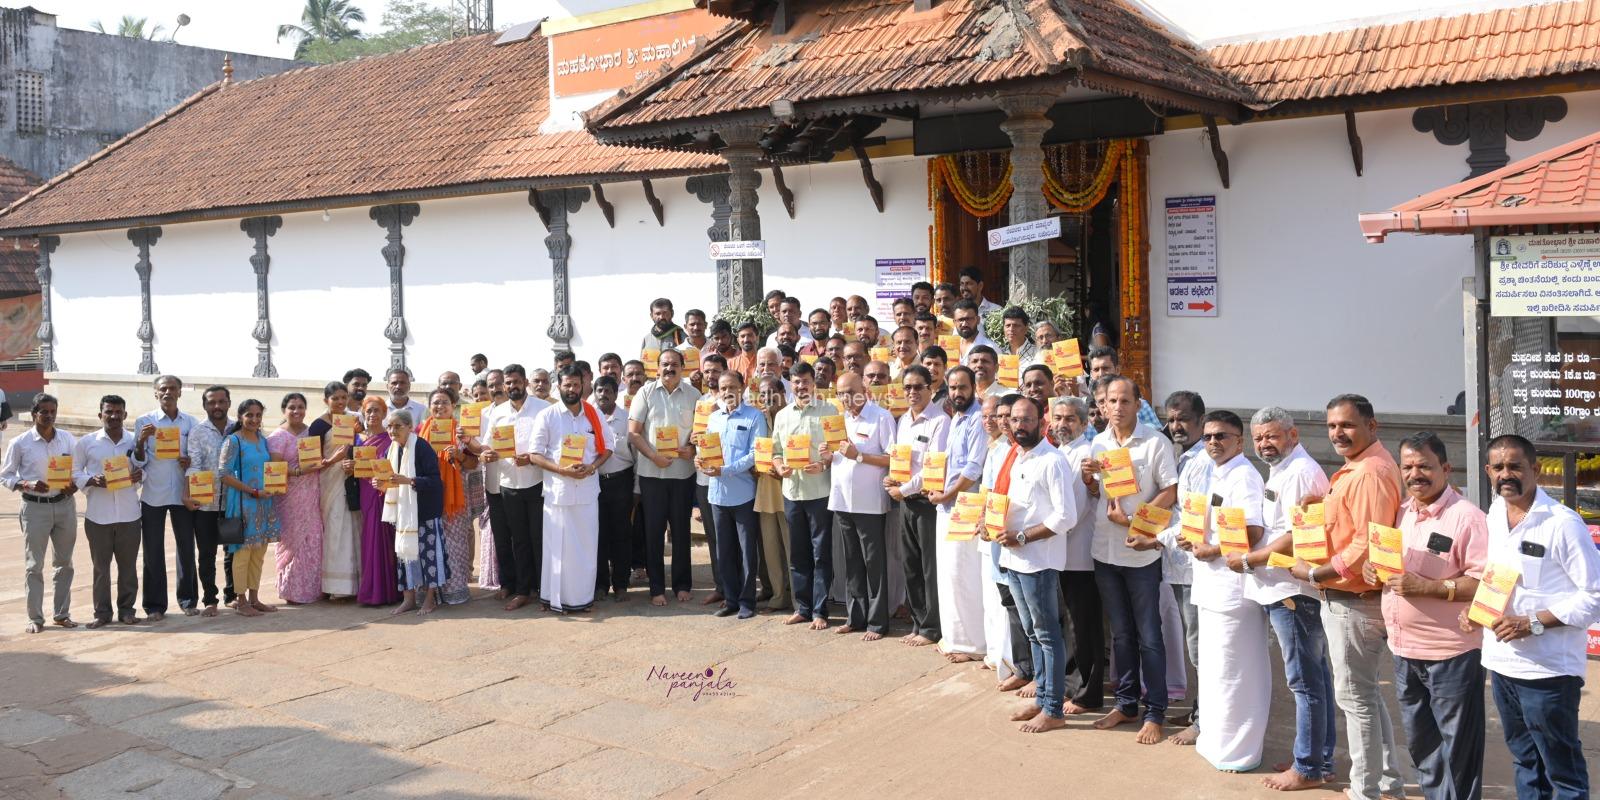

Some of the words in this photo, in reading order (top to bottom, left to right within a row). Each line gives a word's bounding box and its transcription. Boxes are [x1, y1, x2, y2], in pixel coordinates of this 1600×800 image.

[557, 48, 622, 76] ಮಹತೋಭಾರ
[626, 46, 640, 69] ಶ್ರೀ
[1567, 238, 1577, 247] ಶ್ರೀ
[1500, 260, 1510, 271] ಶ್ರೀ
[1511, 260, 1540, 269] ದೇವರಿಗೆ
[1541, 260, 1569, 272] ಪರಿಶುದ್ಧ
[1518, 274, 1560, 285] ಚಿಂತನೆಯಲ್ಲಿ
[1562, 275, 1582, 283] ಕಂಡು
[1495, 289, 1538, 298] ಸಮರ್ಪಿಸಲು
[1170, 300, 1184, 310] ದಾರಿ
[1526, 304, 1541, 314] ಇಲ್ಲಿ
[1541, 303, 1571, 312] ಖರೀದಿಸಿ
[1512, 352, 1542, 365] ತುಪ್ಪದೀಪ
[1544, 352, 1561, 362] ಸೇವೆ
[1530, 369, 1561, 379] ಕುಂಕುಮ
[1531, 387, 1562, 398] ಕುಂಕುಮ
[1530, 404, 1561, 415] ಕುಂಕುಮ
